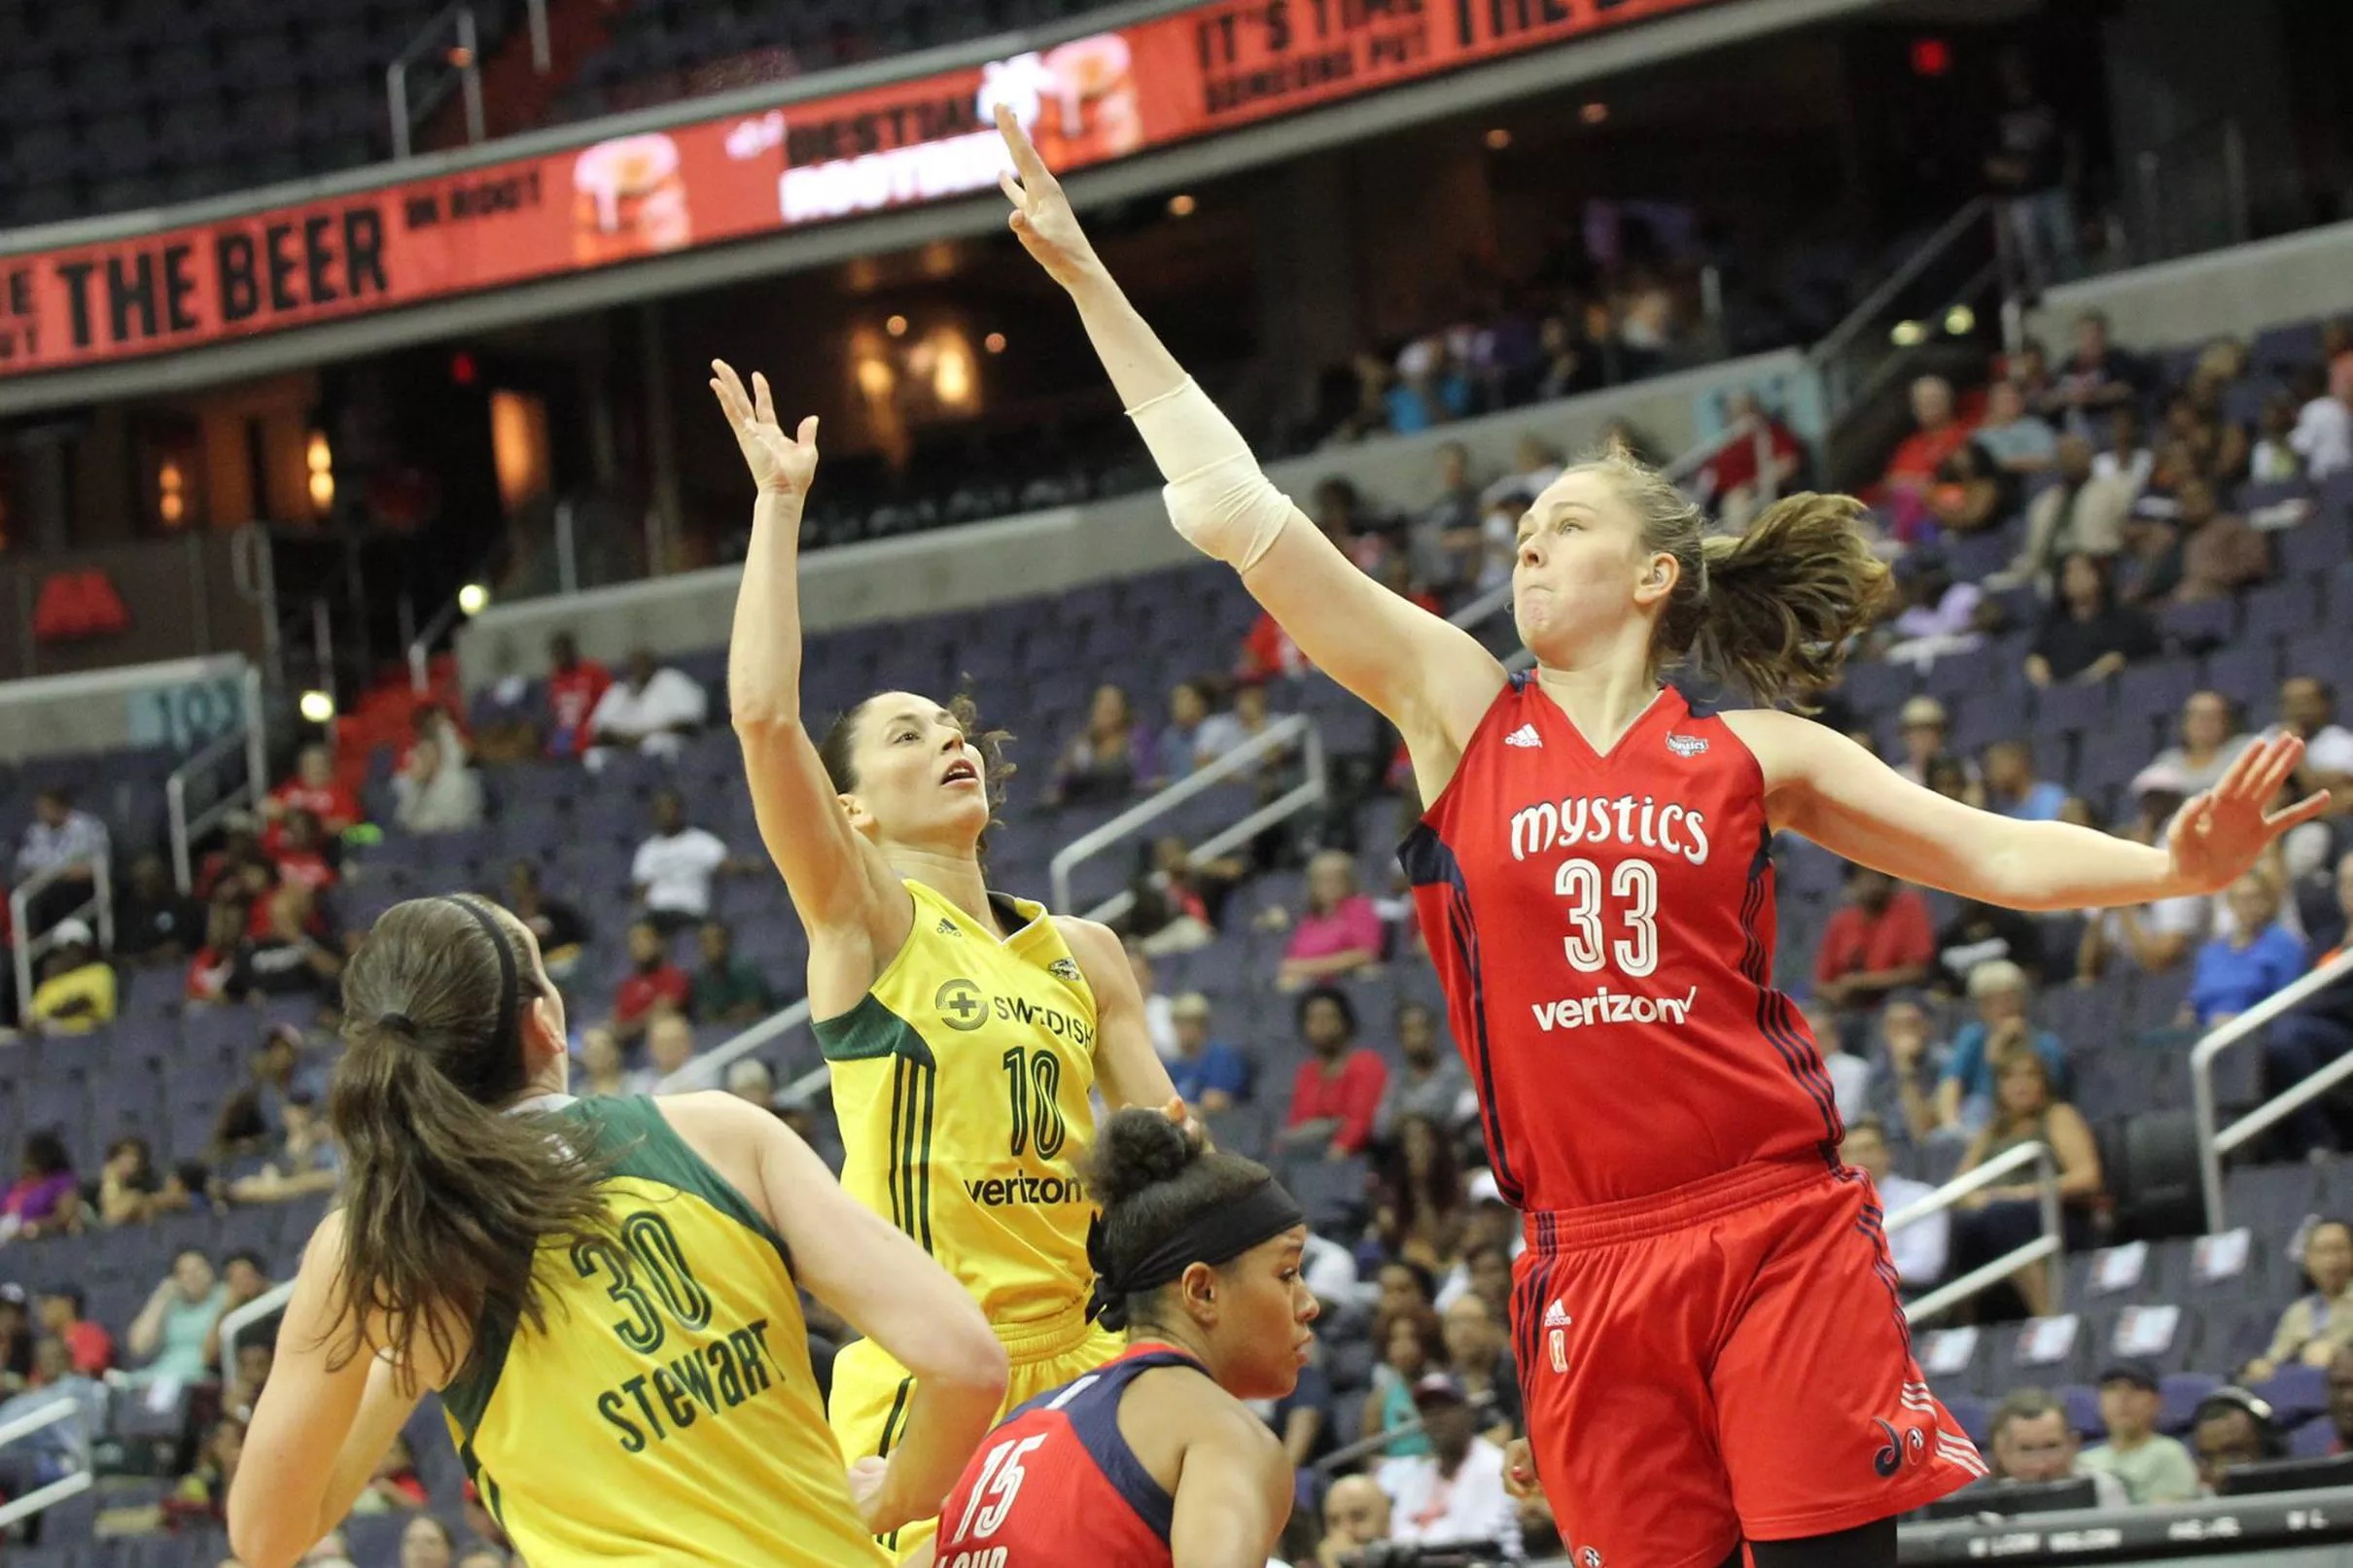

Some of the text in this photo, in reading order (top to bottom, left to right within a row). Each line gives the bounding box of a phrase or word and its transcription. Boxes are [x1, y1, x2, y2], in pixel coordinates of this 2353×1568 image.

[57, 245, 201, 348] THE
[216, 206, 388, 322] BEER
[1555, 857, 1658, 978] 33
[1531, 986, 1687, 1032] verizon
[1002, 1046, 1066, 1161] 10
[964, 1168, 1082, 1206] verizon
[569, 1210, 713, 1355] 30
[951, 1432, 1049, 1546] 15
